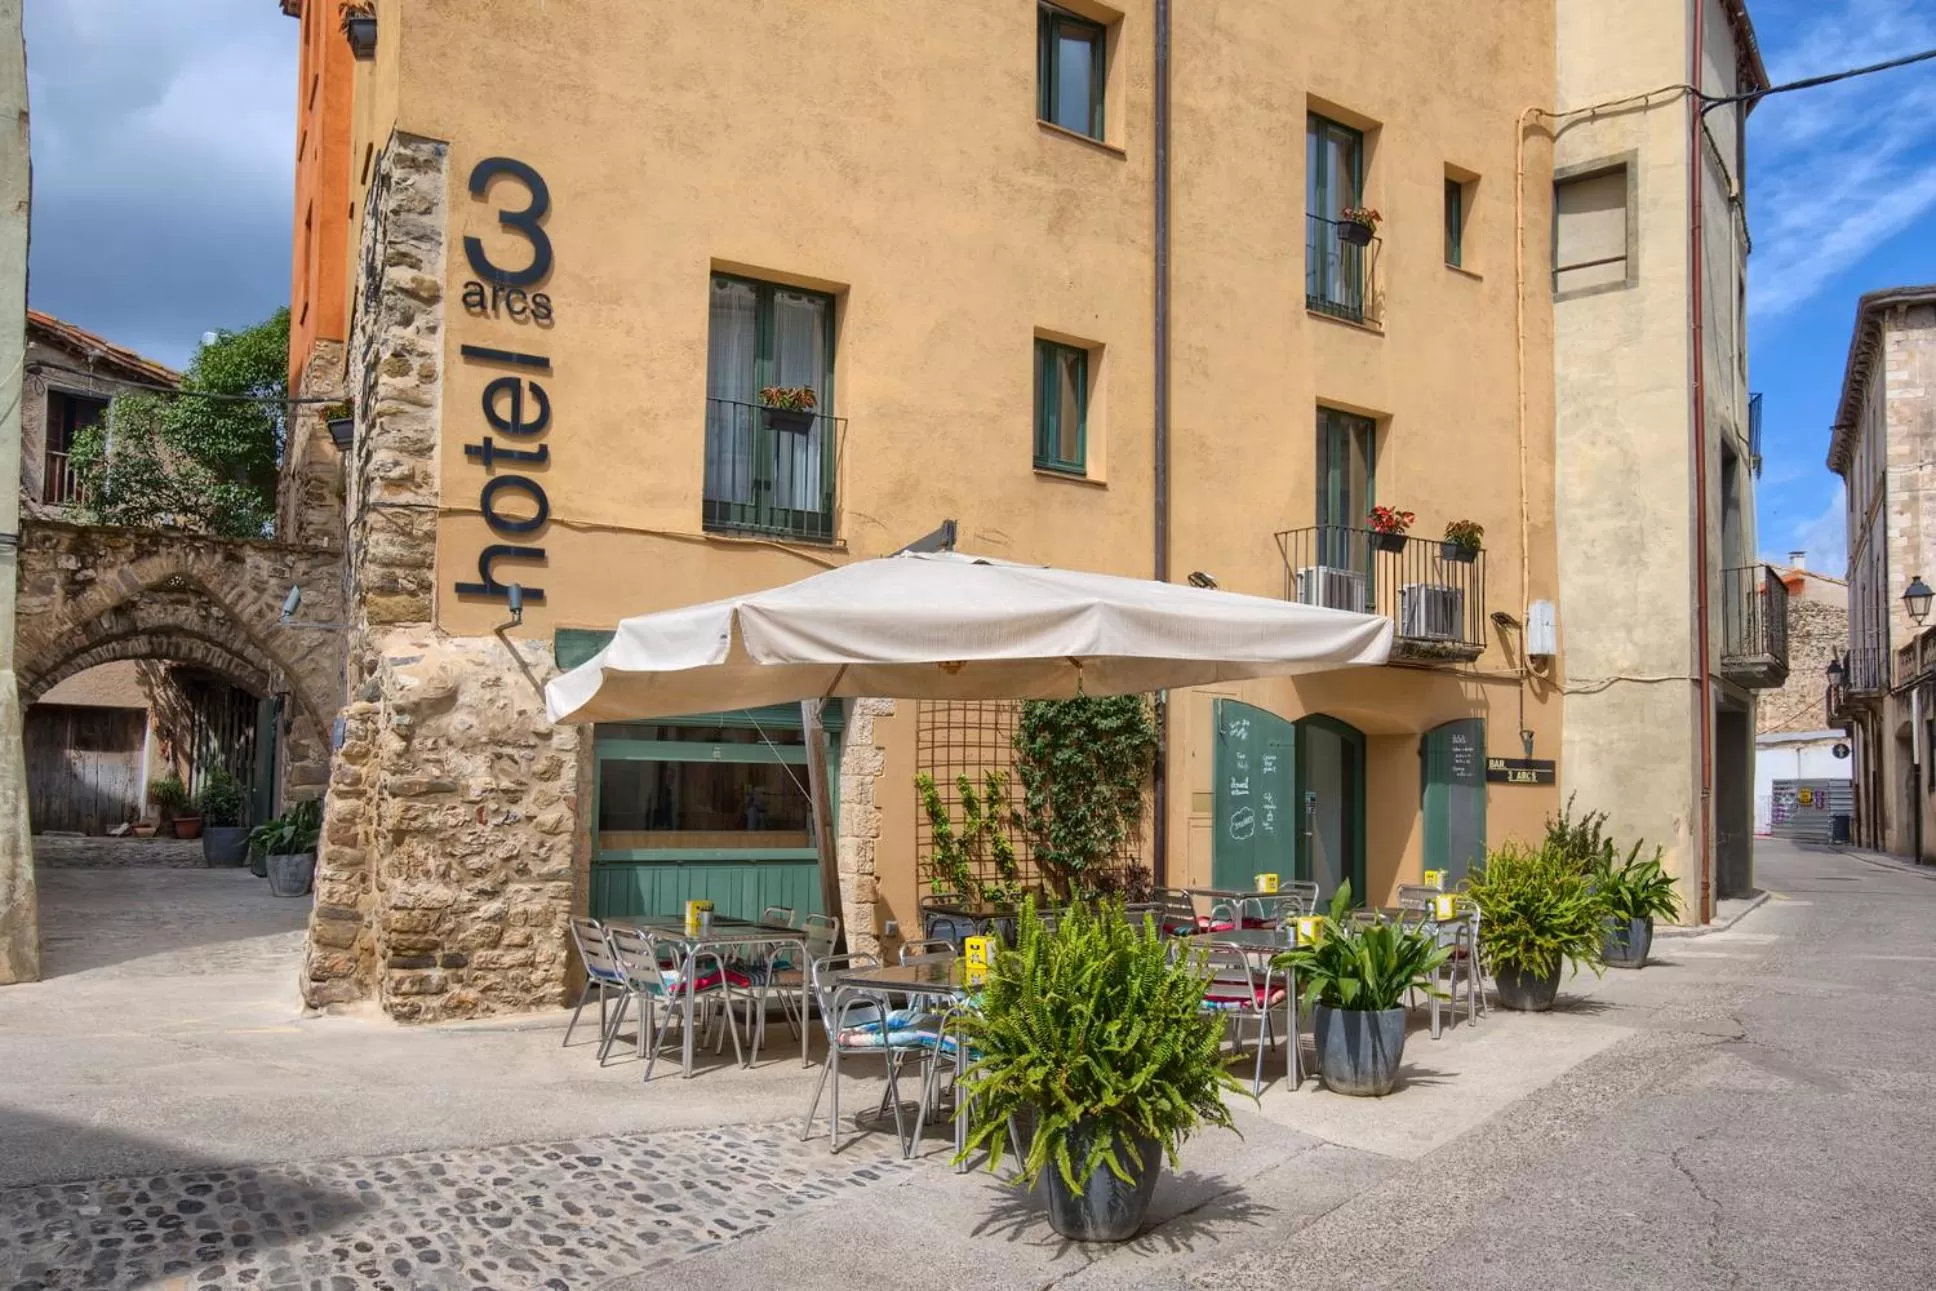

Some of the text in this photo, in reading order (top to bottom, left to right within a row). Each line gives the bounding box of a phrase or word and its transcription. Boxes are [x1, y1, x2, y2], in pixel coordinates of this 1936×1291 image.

[463, 156, 552, 287] 3
[462, 281, 552, 320] arcs
[454, 344, 550, 600] hotel
